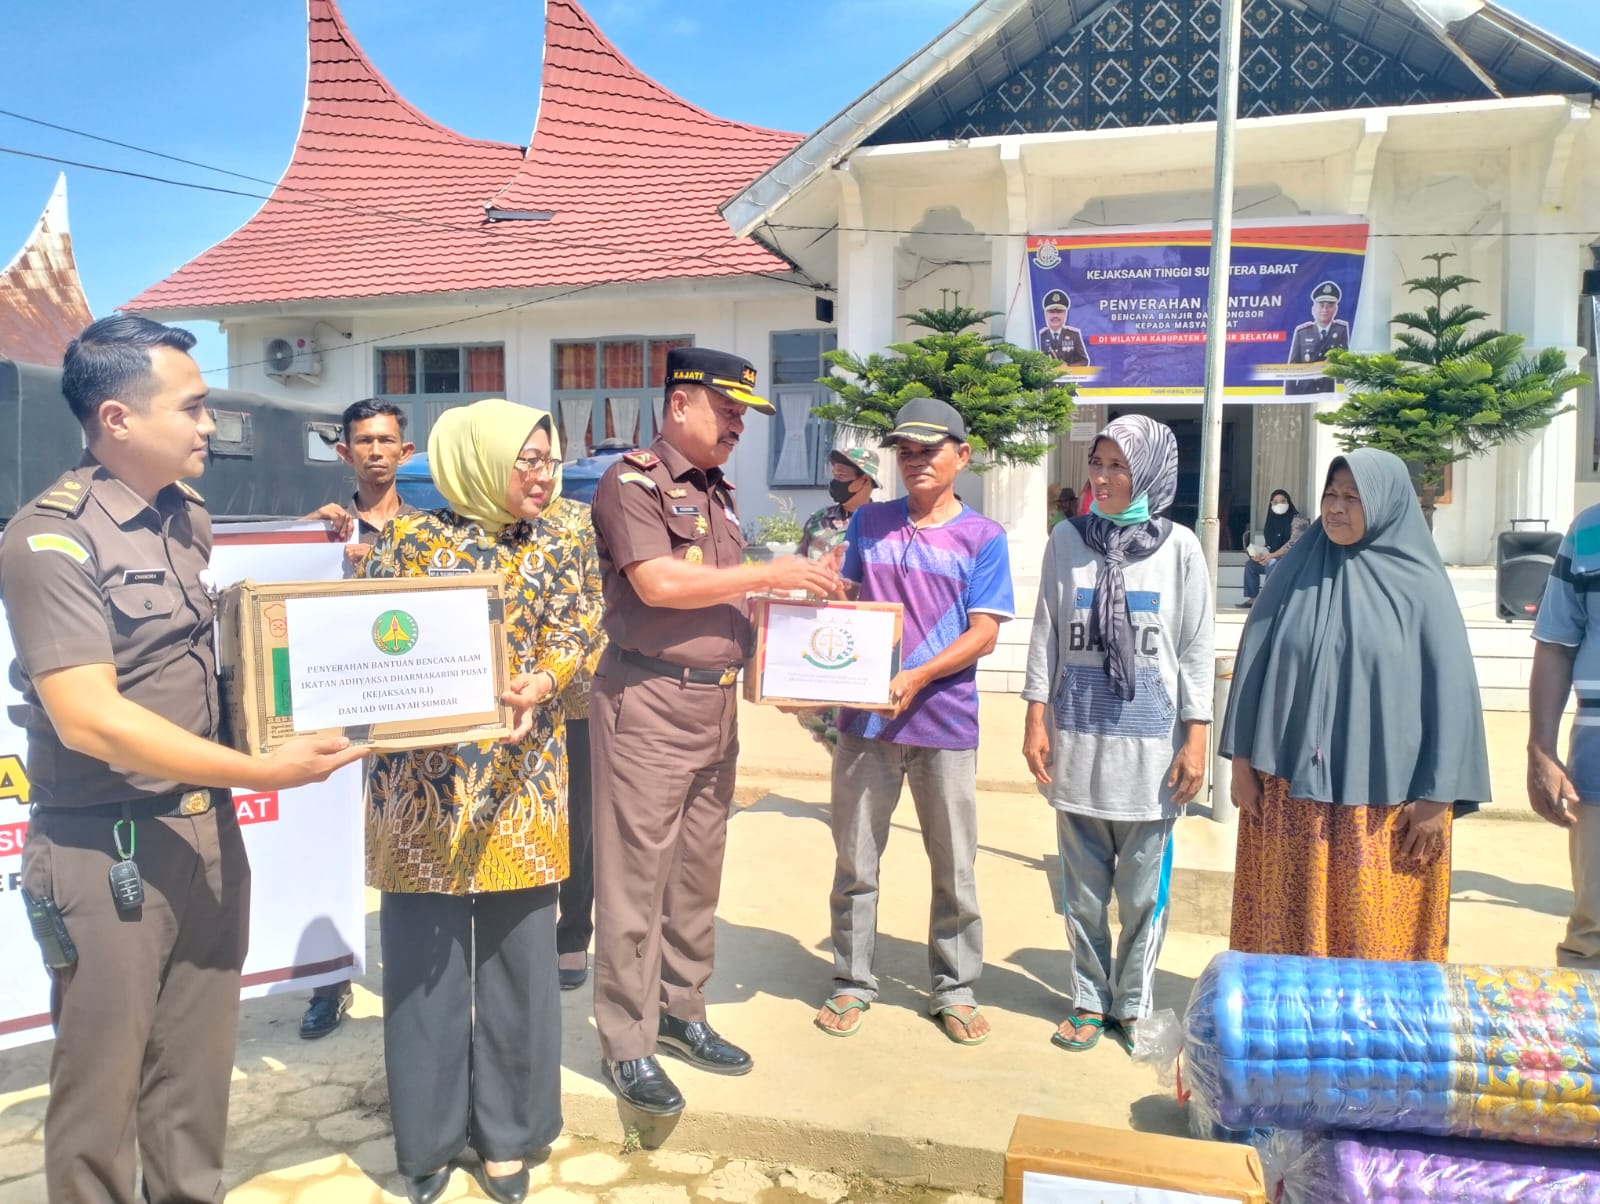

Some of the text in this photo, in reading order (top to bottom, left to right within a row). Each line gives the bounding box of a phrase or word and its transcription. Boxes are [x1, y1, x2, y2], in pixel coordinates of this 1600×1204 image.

[1086, 263, 1298, 280] KEJAKSAAN TINGGI SUTERA BARAT
[1099, 295, 1282, 311] PENYERAHAN NTUAN
[1111, 310, 1264, 321] BENCANA BANJIR DA ONGSOR
[1135, 320, 1238, 329] KEPADA MASYAAT
[1110, 335, 1148, 343] WILAYAH
[1150, 334, 1200, 342] KABUPATEN
[1240, 332, 1279, 341] SELATAN
[673, 370, 704, 380] KAJATI
[307, 654, 481, 674] PENYERAHAN BANTUAN BENCANA ALAM
[301, 667, 488, 690] IKATAN ADHYAKSA DHARMAKARINI PUSAT
[362, 688, 417, 700] (KEJAKSAAN
[338, 697, 458, 716] DAN IAD WILAYAH SUMBAR
